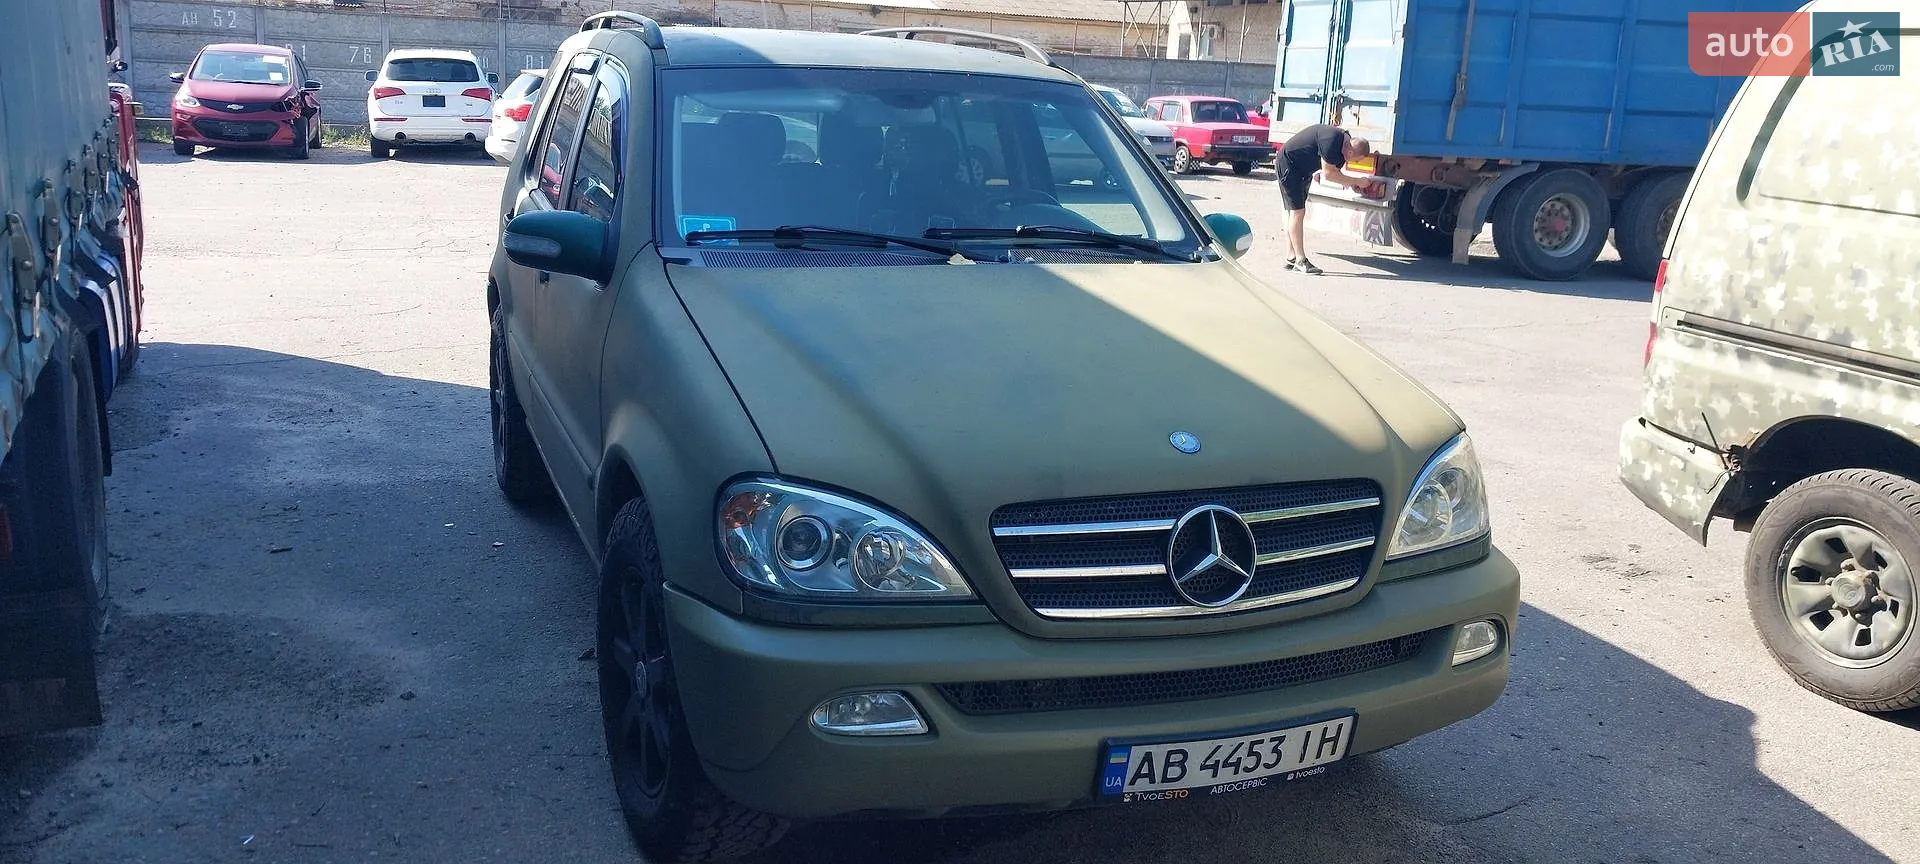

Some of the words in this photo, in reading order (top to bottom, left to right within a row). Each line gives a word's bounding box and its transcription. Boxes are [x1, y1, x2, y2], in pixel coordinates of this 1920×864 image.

[213, 9, 237, 28] 52
[349, 46, 372, 64] 76
[1128, 749, 1189, 787] AB
[1200, 734, 1287, 779] 4453
[1299, 722, 1344, 764] IH
[1296, 766, 1326, 779] tvoesto
[1105, 776, 1123, 788] UA
[1210, 777, 1268, 795] АВТОСЕРВІС
